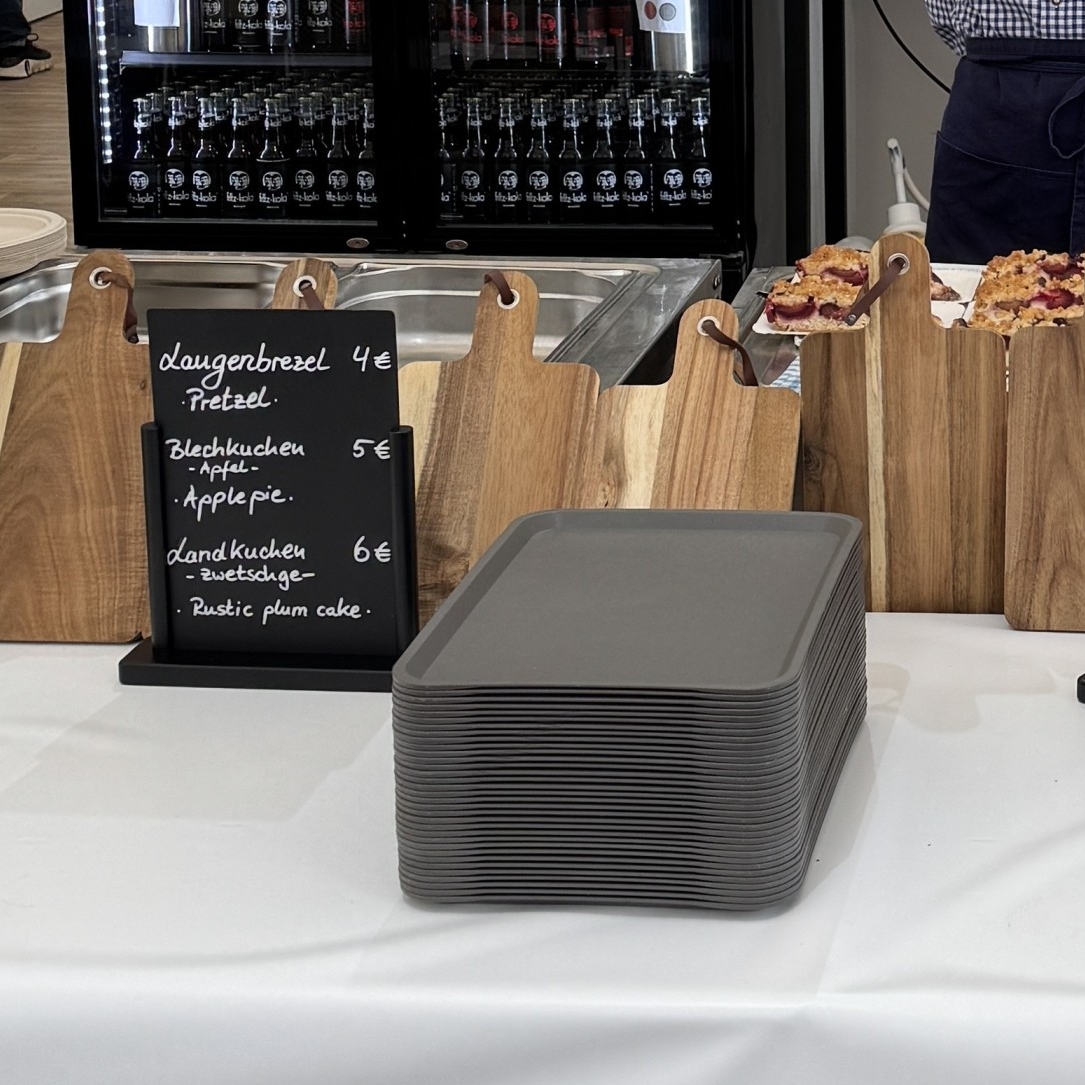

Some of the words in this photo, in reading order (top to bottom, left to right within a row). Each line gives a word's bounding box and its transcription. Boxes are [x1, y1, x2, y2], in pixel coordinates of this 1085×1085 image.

[159, 342, 331, 389] Laugenbrezel
[165, 435, 305, 460] Blechkuchen
[190, 596, 254, 617] Rustic
[262, 598, 308, 625] plum
[316, 597, 362, 618] cake
